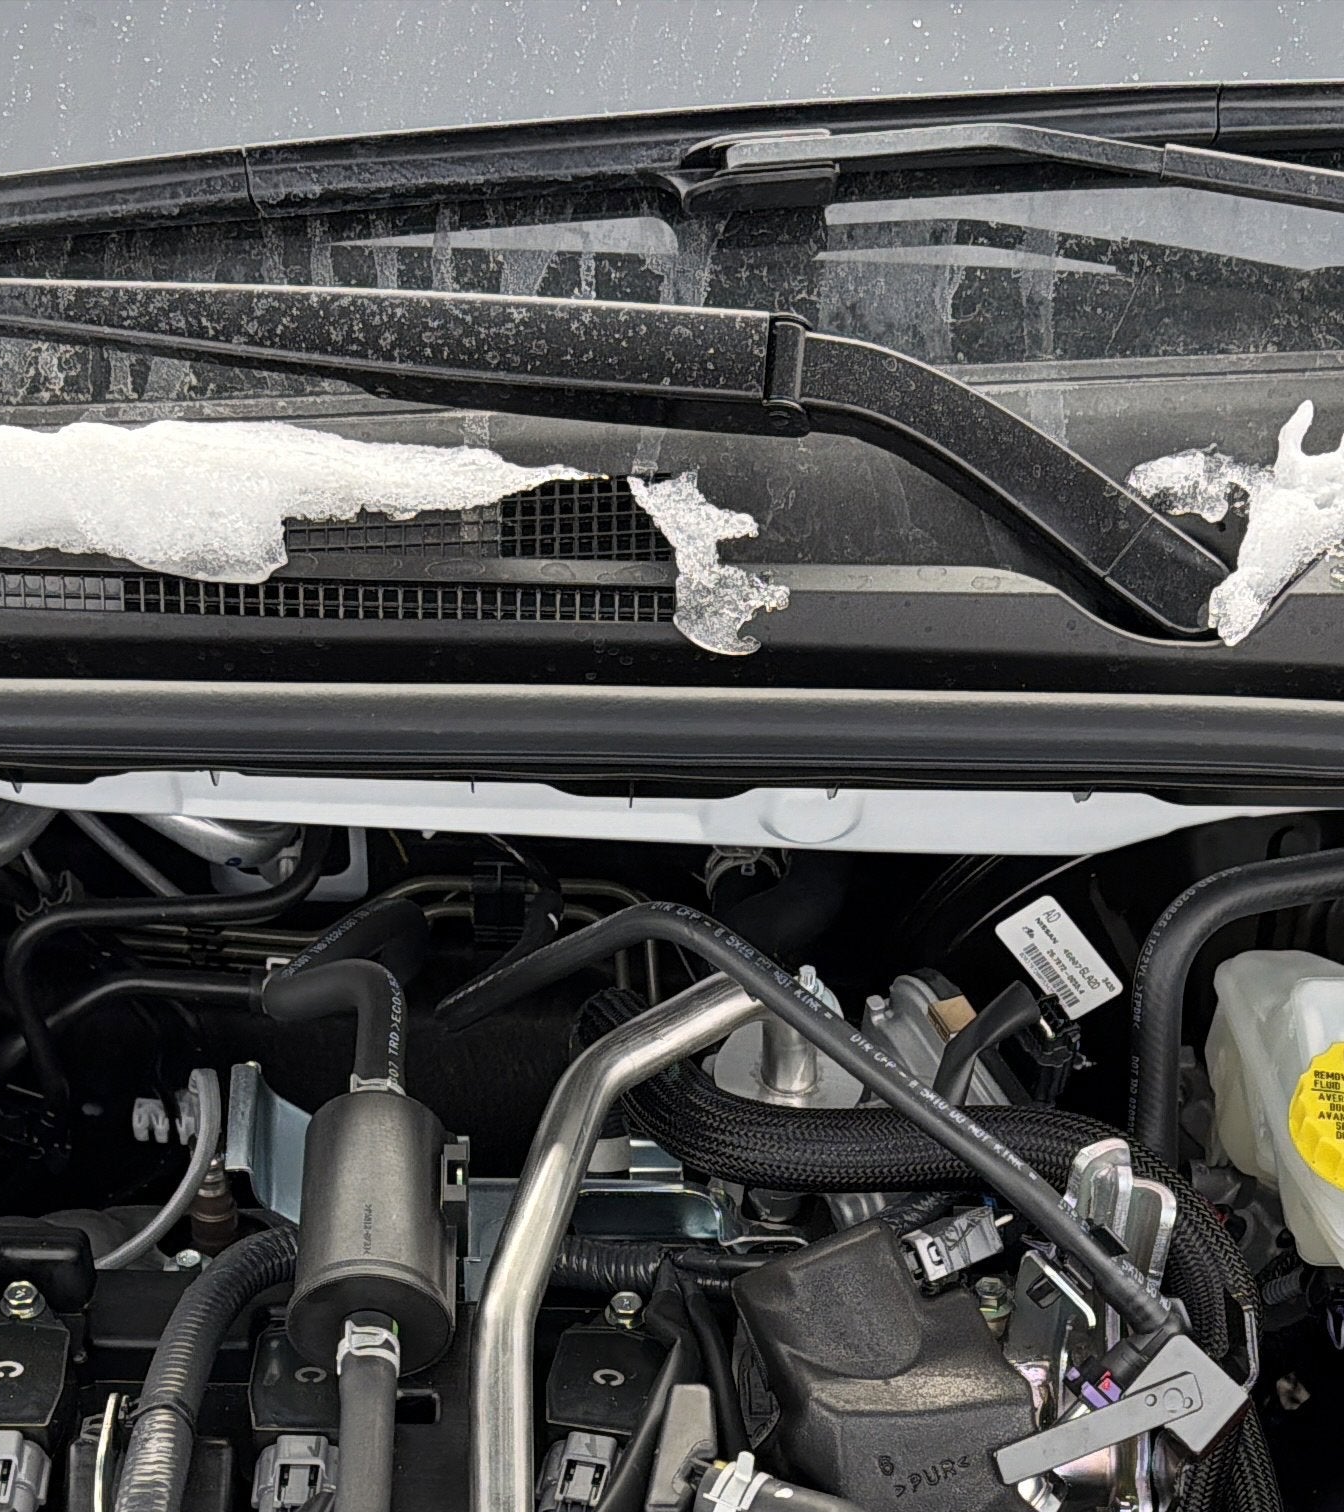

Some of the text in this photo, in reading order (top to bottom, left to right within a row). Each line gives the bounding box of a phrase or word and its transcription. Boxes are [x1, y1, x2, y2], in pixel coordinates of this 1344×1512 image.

[1034, 916, 1059, 945] NISSAN
[1313, 1079, 1340, 1090] FLUID
[294, 1366, 328, 1384] C
[593, 1367, 625, 1388] C
